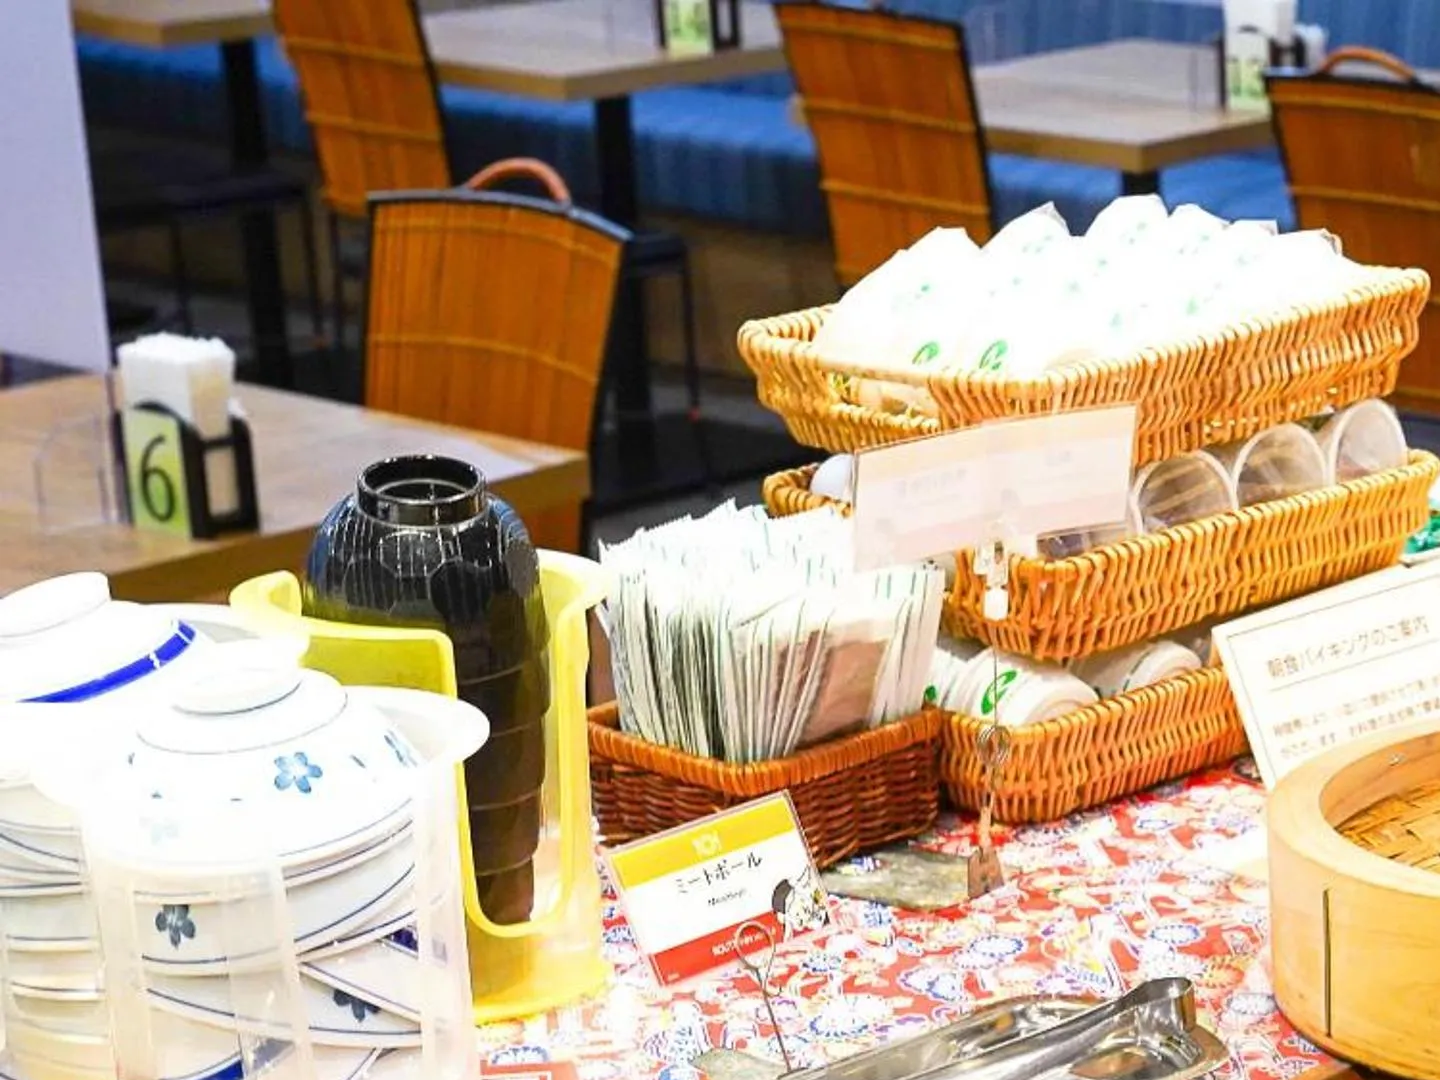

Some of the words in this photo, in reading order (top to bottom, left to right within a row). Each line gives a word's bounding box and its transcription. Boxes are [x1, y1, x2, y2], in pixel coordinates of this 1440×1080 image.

[140, 434, 175, 522] 6
[1267, 616, 1430, 678] 朝食バイキングのご案内
[676, 851, 763, 894] ミートボール
